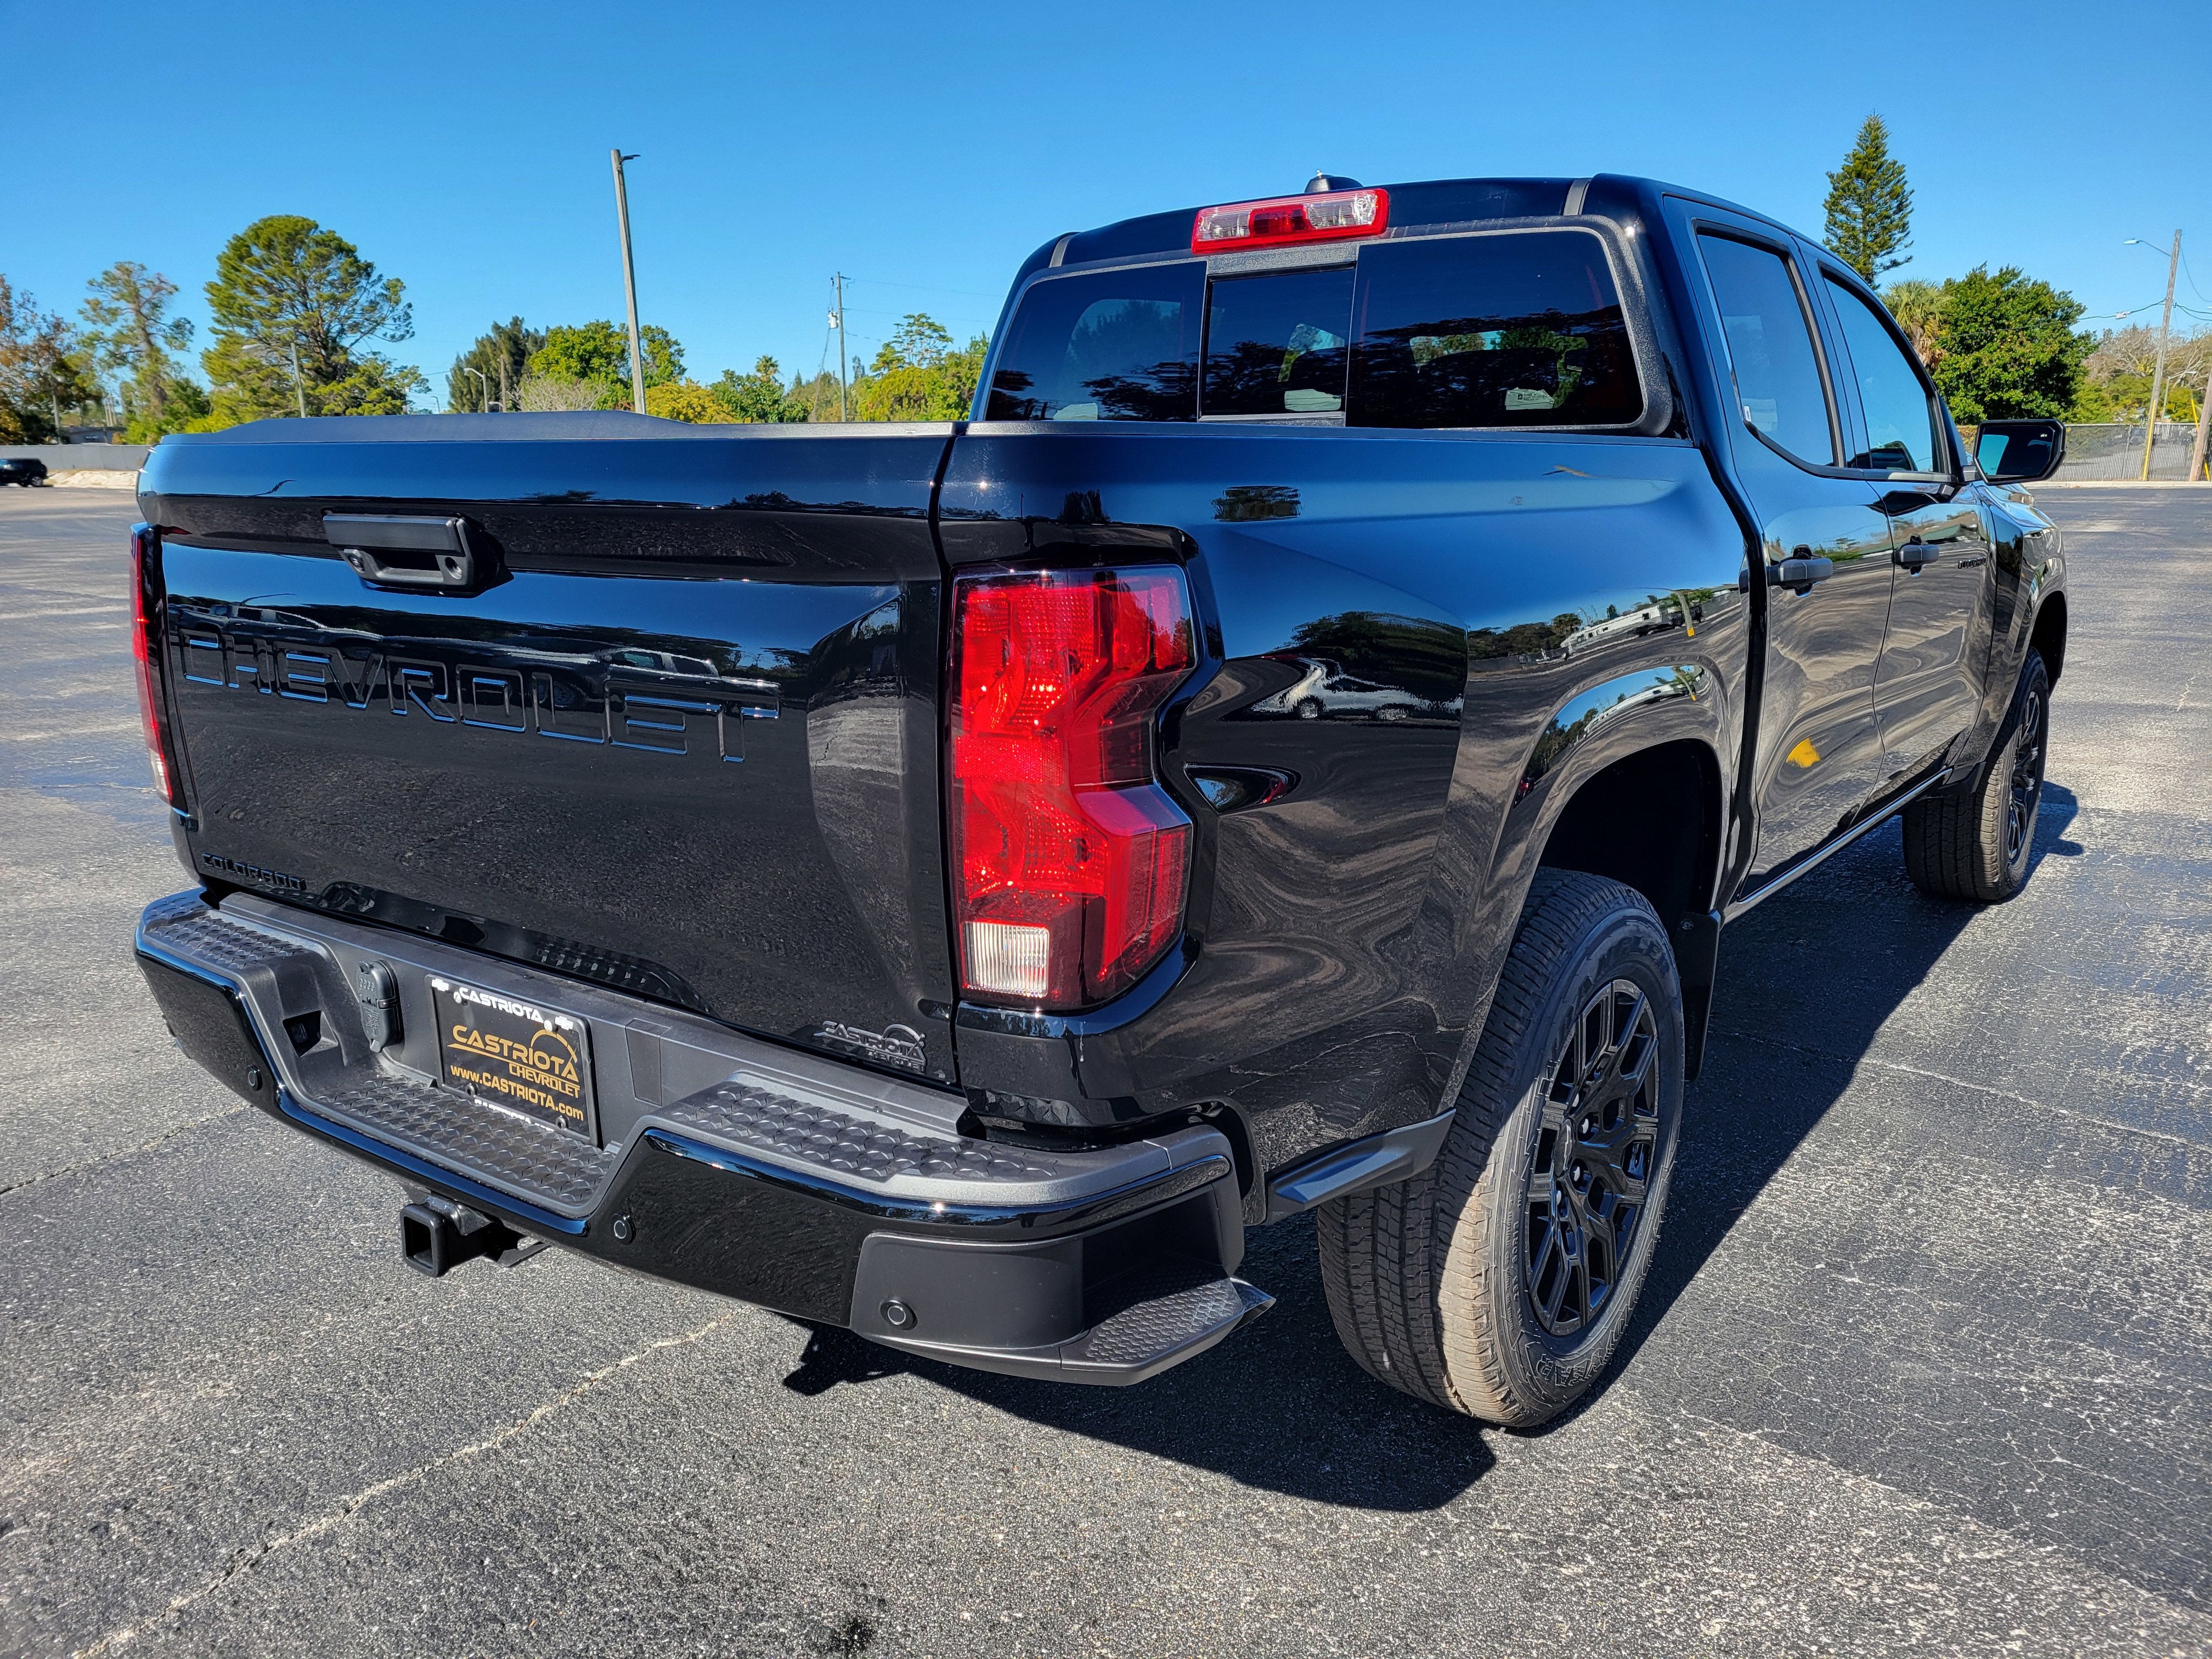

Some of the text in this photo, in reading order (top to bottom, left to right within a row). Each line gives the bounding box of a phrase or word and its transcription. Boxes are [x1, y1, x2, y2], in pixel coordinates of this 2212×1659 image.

[178, 627, 780, 764] CHEVROLET
[201, 853, 307, 891] COLORADO
[459, 987, 544, 1024] CASTRIOTA
[452, 1024, 579, 1083] CASTRIOTA
[450, 1065, 584, 1121] www.CASTRIOTA.com
[509, 1063, 580, 1099] CHEVROLET
